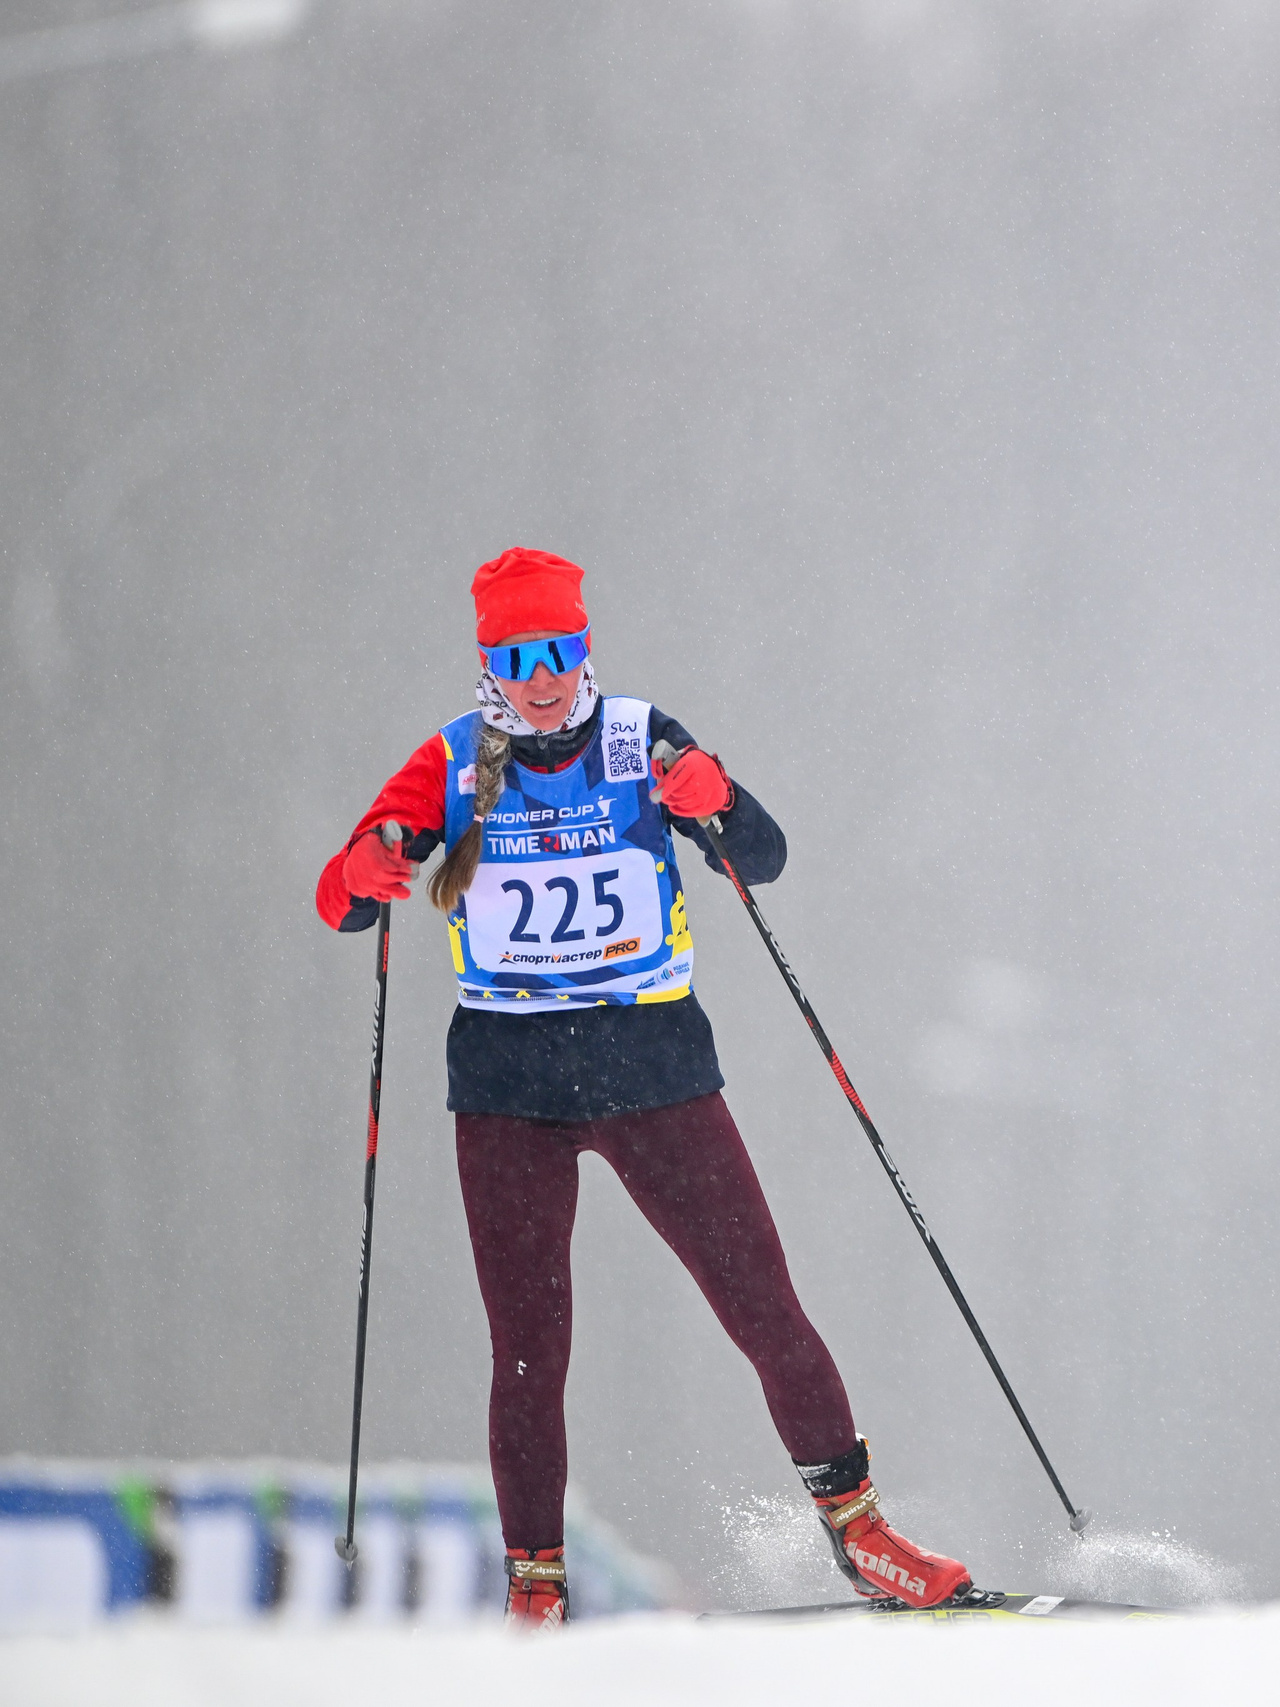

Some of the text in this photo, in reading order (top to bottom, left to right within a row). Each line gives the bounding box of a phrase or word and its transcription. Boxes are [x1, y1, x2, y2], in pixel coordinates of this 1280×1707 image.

[487, 804, 595, 824] PIONER CUP
[500, 868, 624, 944] 225
[605, 940, 638, 957] PRO
[835, 1500, 867, 1522] alpina
[532, 1566, 565, 1576] alpina
[846, 1541, 927, 1598] lpina
